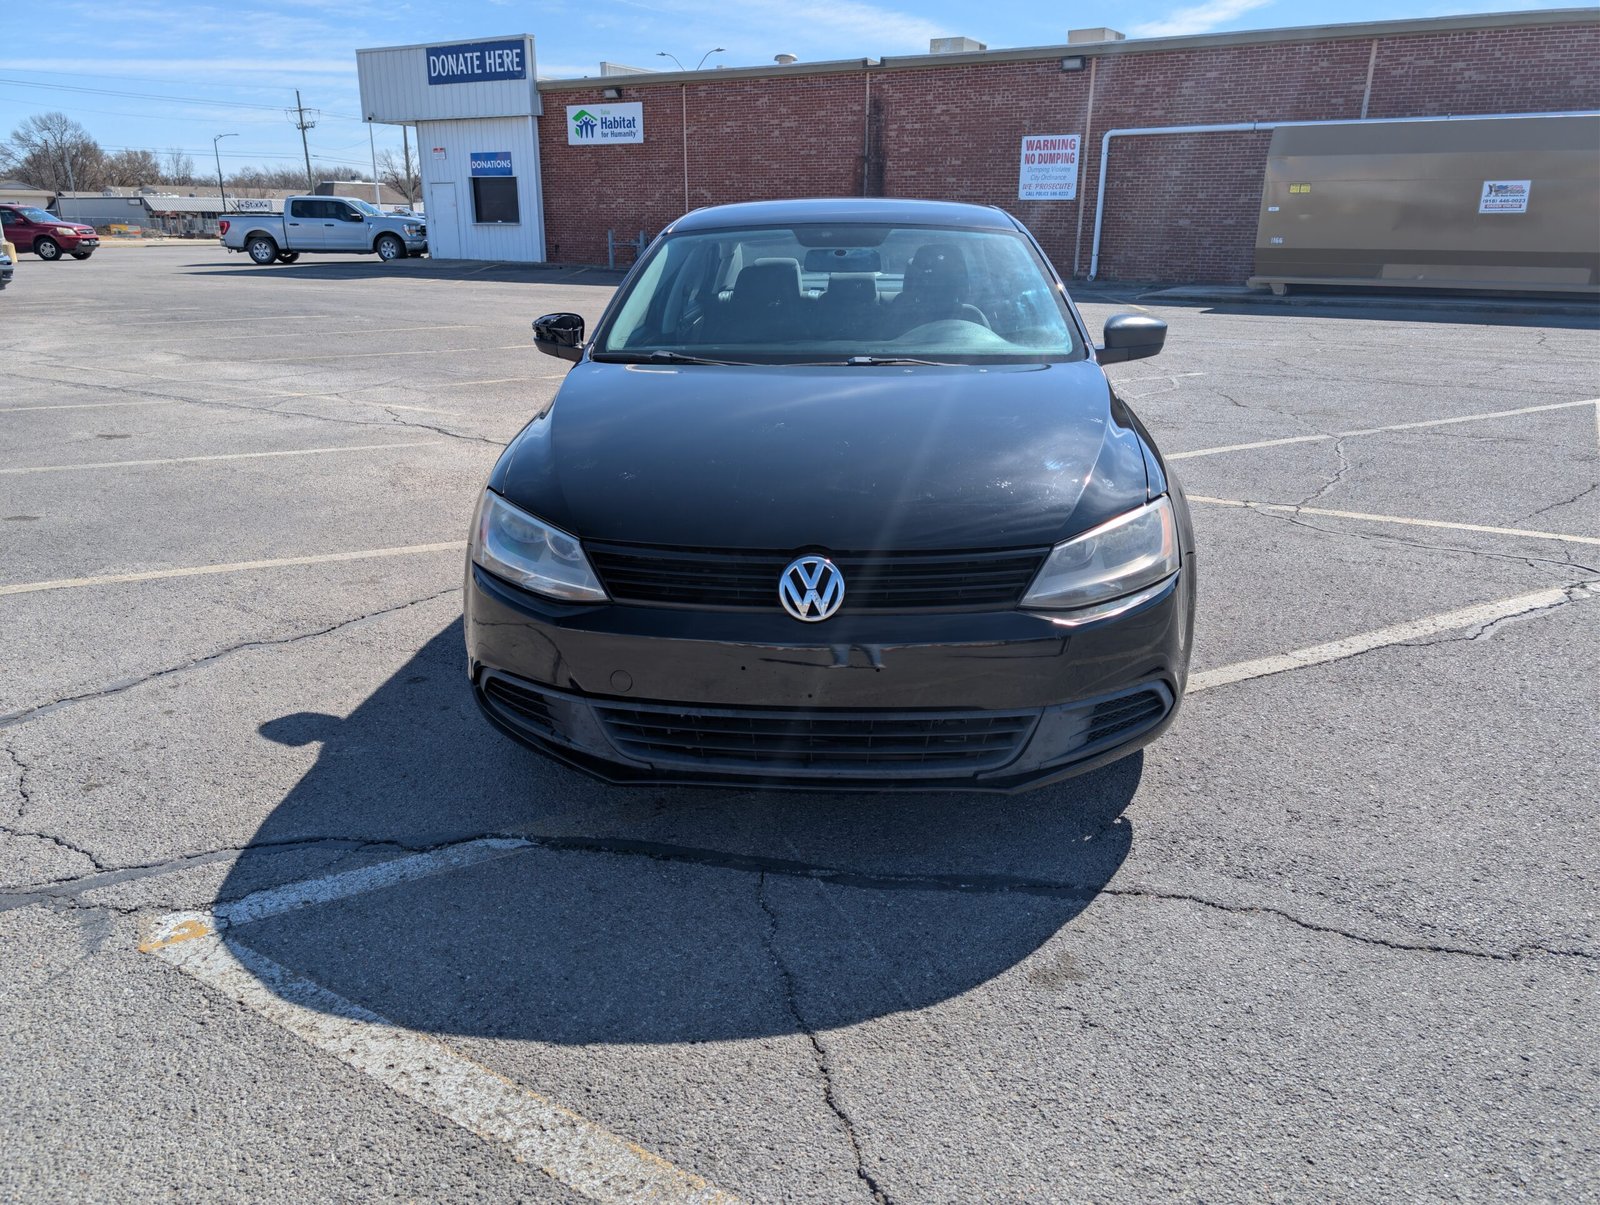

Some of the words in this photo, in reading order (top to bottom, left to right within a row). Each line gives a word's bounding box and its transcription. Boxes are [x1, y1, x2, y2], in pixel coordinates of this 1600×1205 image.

[430, 52, 482, 77] DONATE
[485, 49, 522, 73] HERE
[600, 116, 636, 129] Habitat
[611, 130, 636, 139] Humanity
[1026, 139, 1076, 151] WARNING
[471, 160, 511, 169] DONATIONS
[1025, 153, 1036, 165] NO
[1038, 152, 1075, 165] DUMPING
[1027, 166, 1051, 174] Dumping
[780, 557, 844, 621] VW
